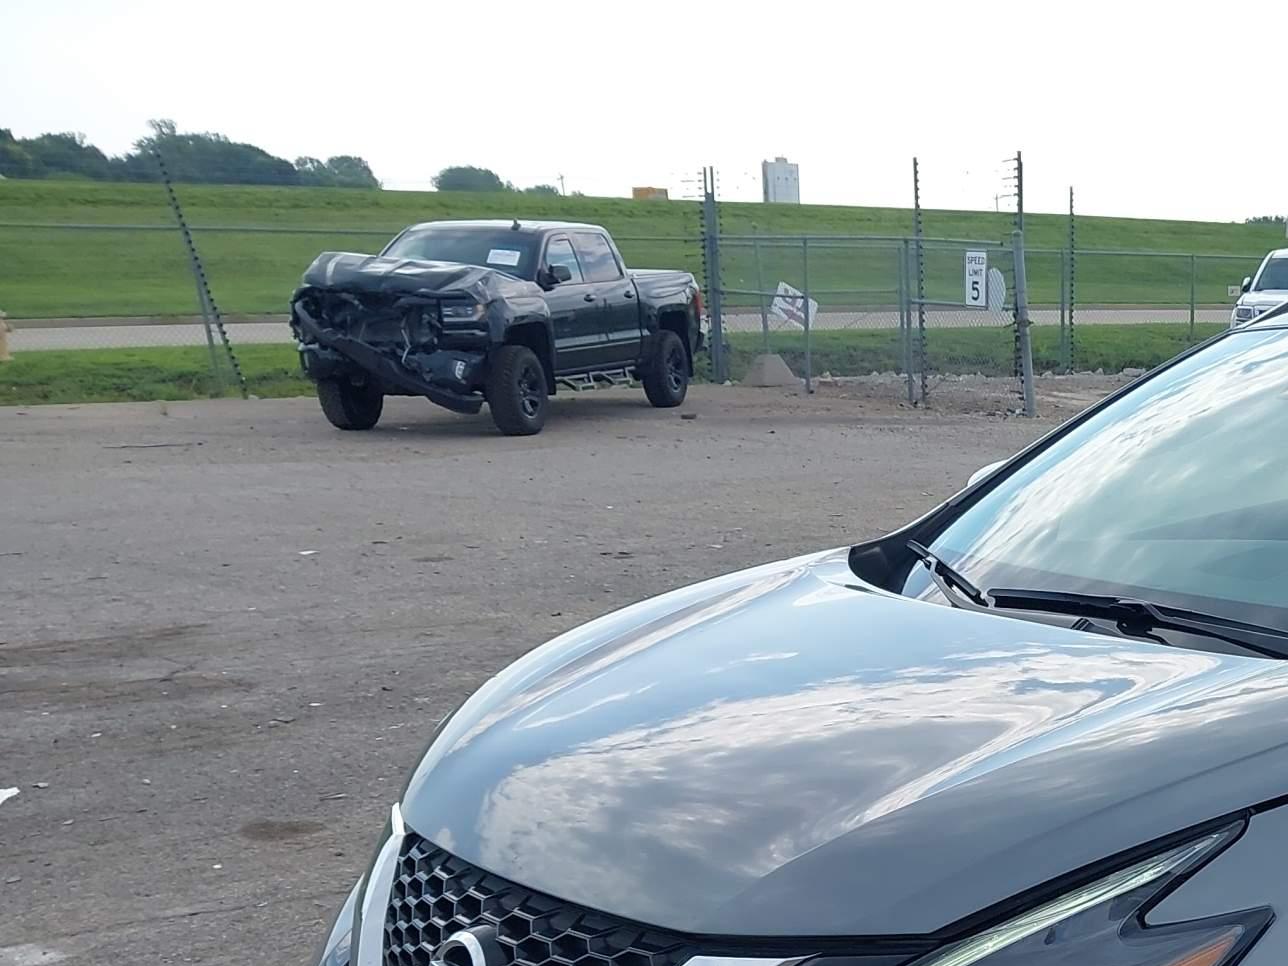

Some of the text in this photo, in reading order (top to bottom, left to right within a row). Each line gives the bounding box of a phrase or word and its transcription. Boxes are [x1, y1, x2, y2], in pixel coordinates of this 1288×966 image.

[967, 256, 985, 265] SPEED
[968, 268, 983, 276] LIMIT
[971, 281, 980, 301] 5
